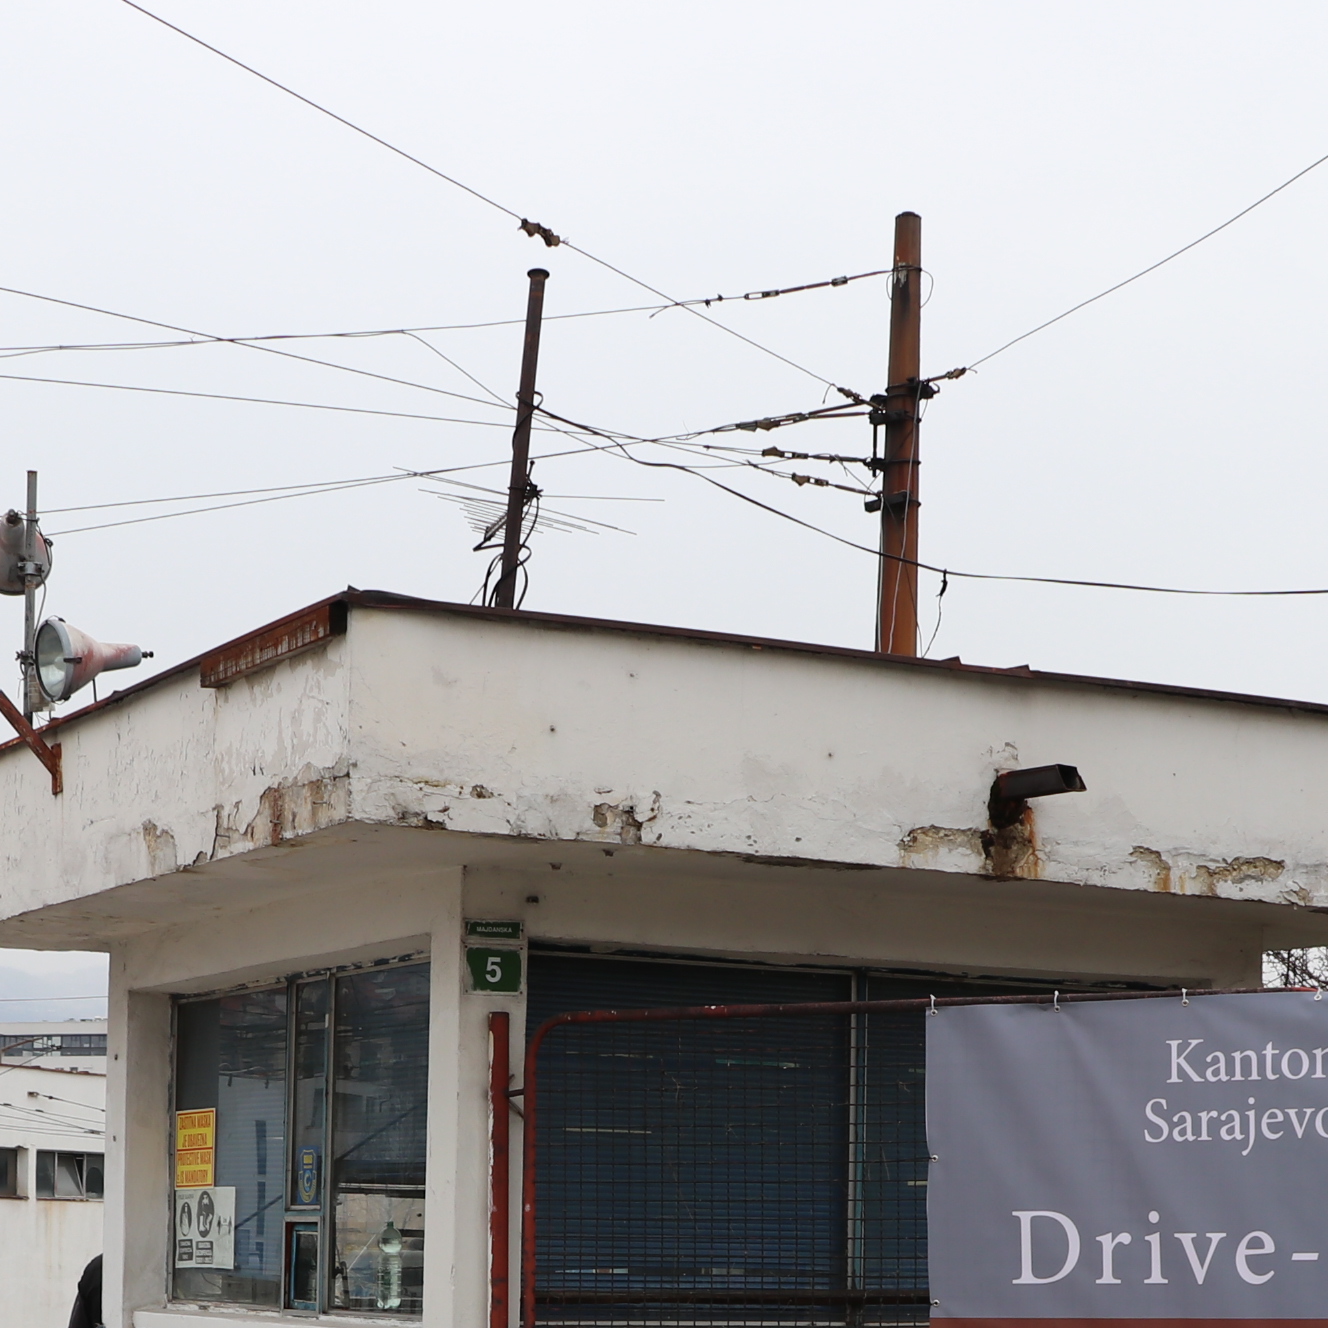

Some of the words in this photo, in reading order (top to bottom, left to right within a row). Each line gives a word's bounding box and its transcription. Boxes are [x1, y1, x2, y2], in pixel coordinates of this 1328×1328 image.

[485, 956, 502, 983] 5
[187, 1133, 208, 1147] OBAVEZNA
[177, 1152, 200, 1166] PROTECTIVE
[199, 1150, 212, 1165] MASK
[184, 1169, 209, 1184] MANDATORY
